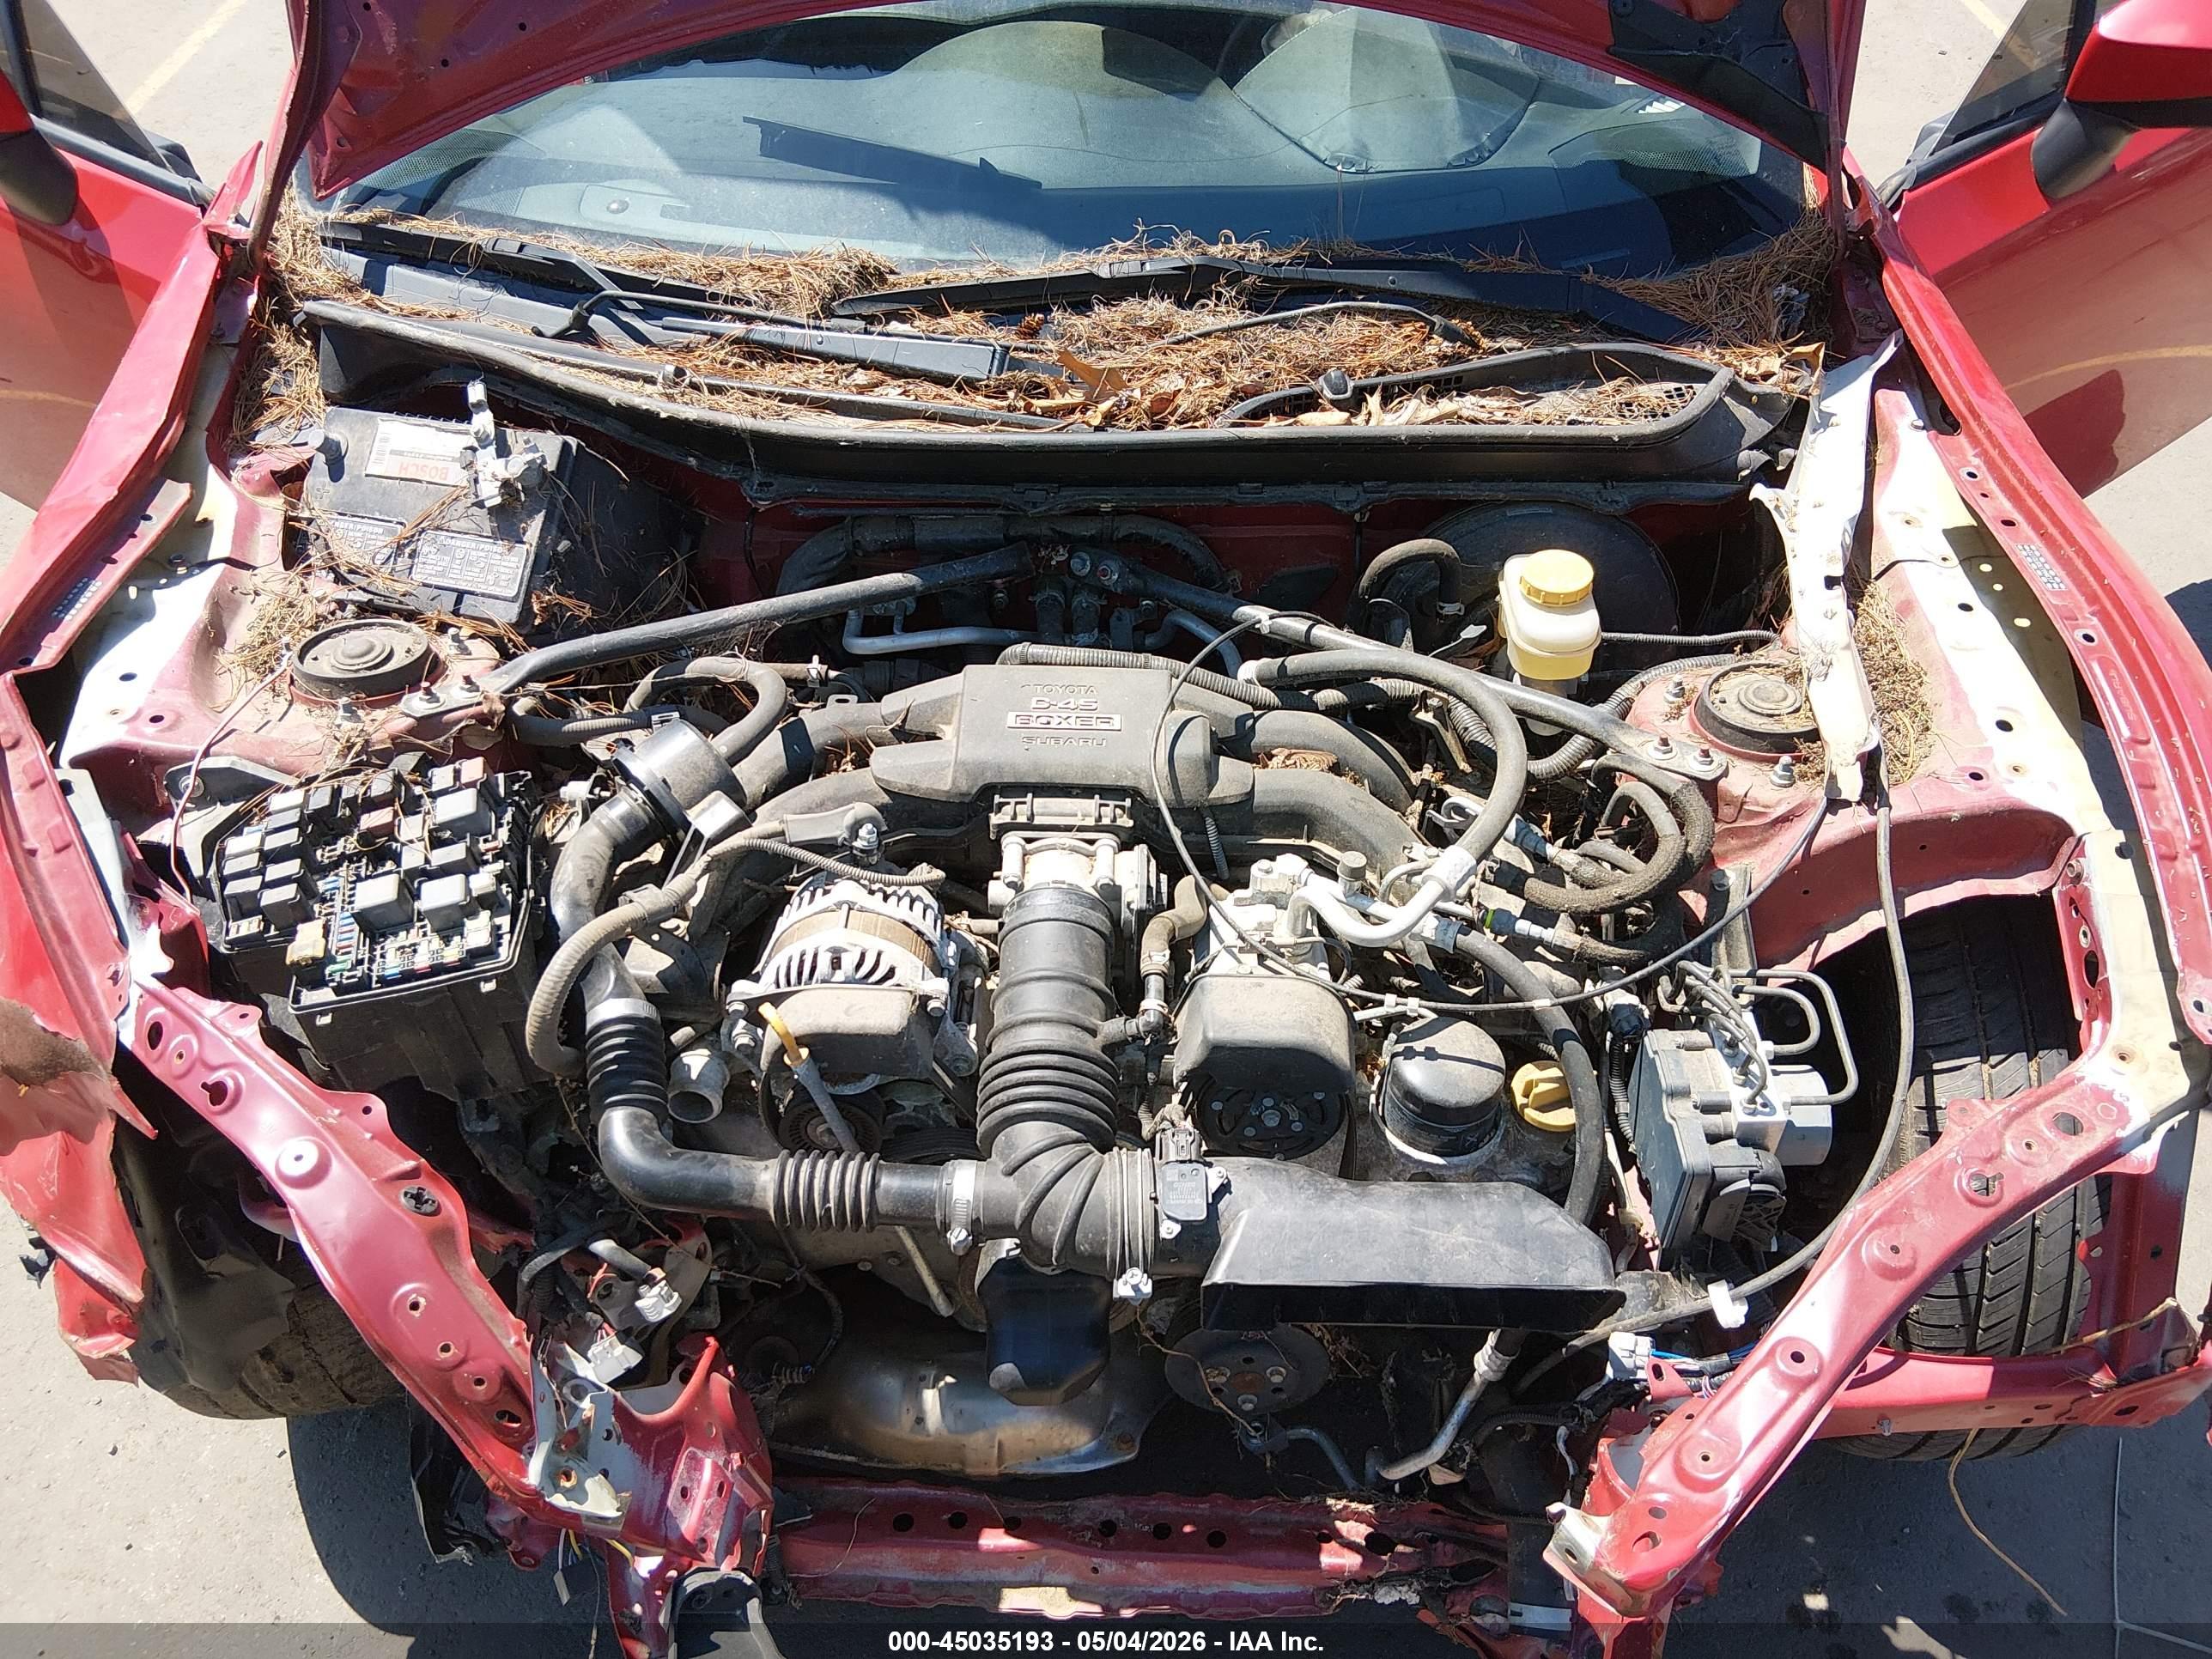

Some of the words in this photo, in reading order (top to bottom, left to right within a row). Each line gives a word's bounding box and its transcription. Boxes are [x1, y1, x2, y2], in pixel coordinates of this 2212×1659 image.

[398, 461, 449, 481] BOSCH
[444, 537, 508, 555] DANGER/POISO
[1034, 684, 1098, 695] TOYOTA
[1031, 696, 1099, 712] D-4S
[1015, 714, 1115, 727] BOXER
[1022, 736, 1107, 747] SUBARU
